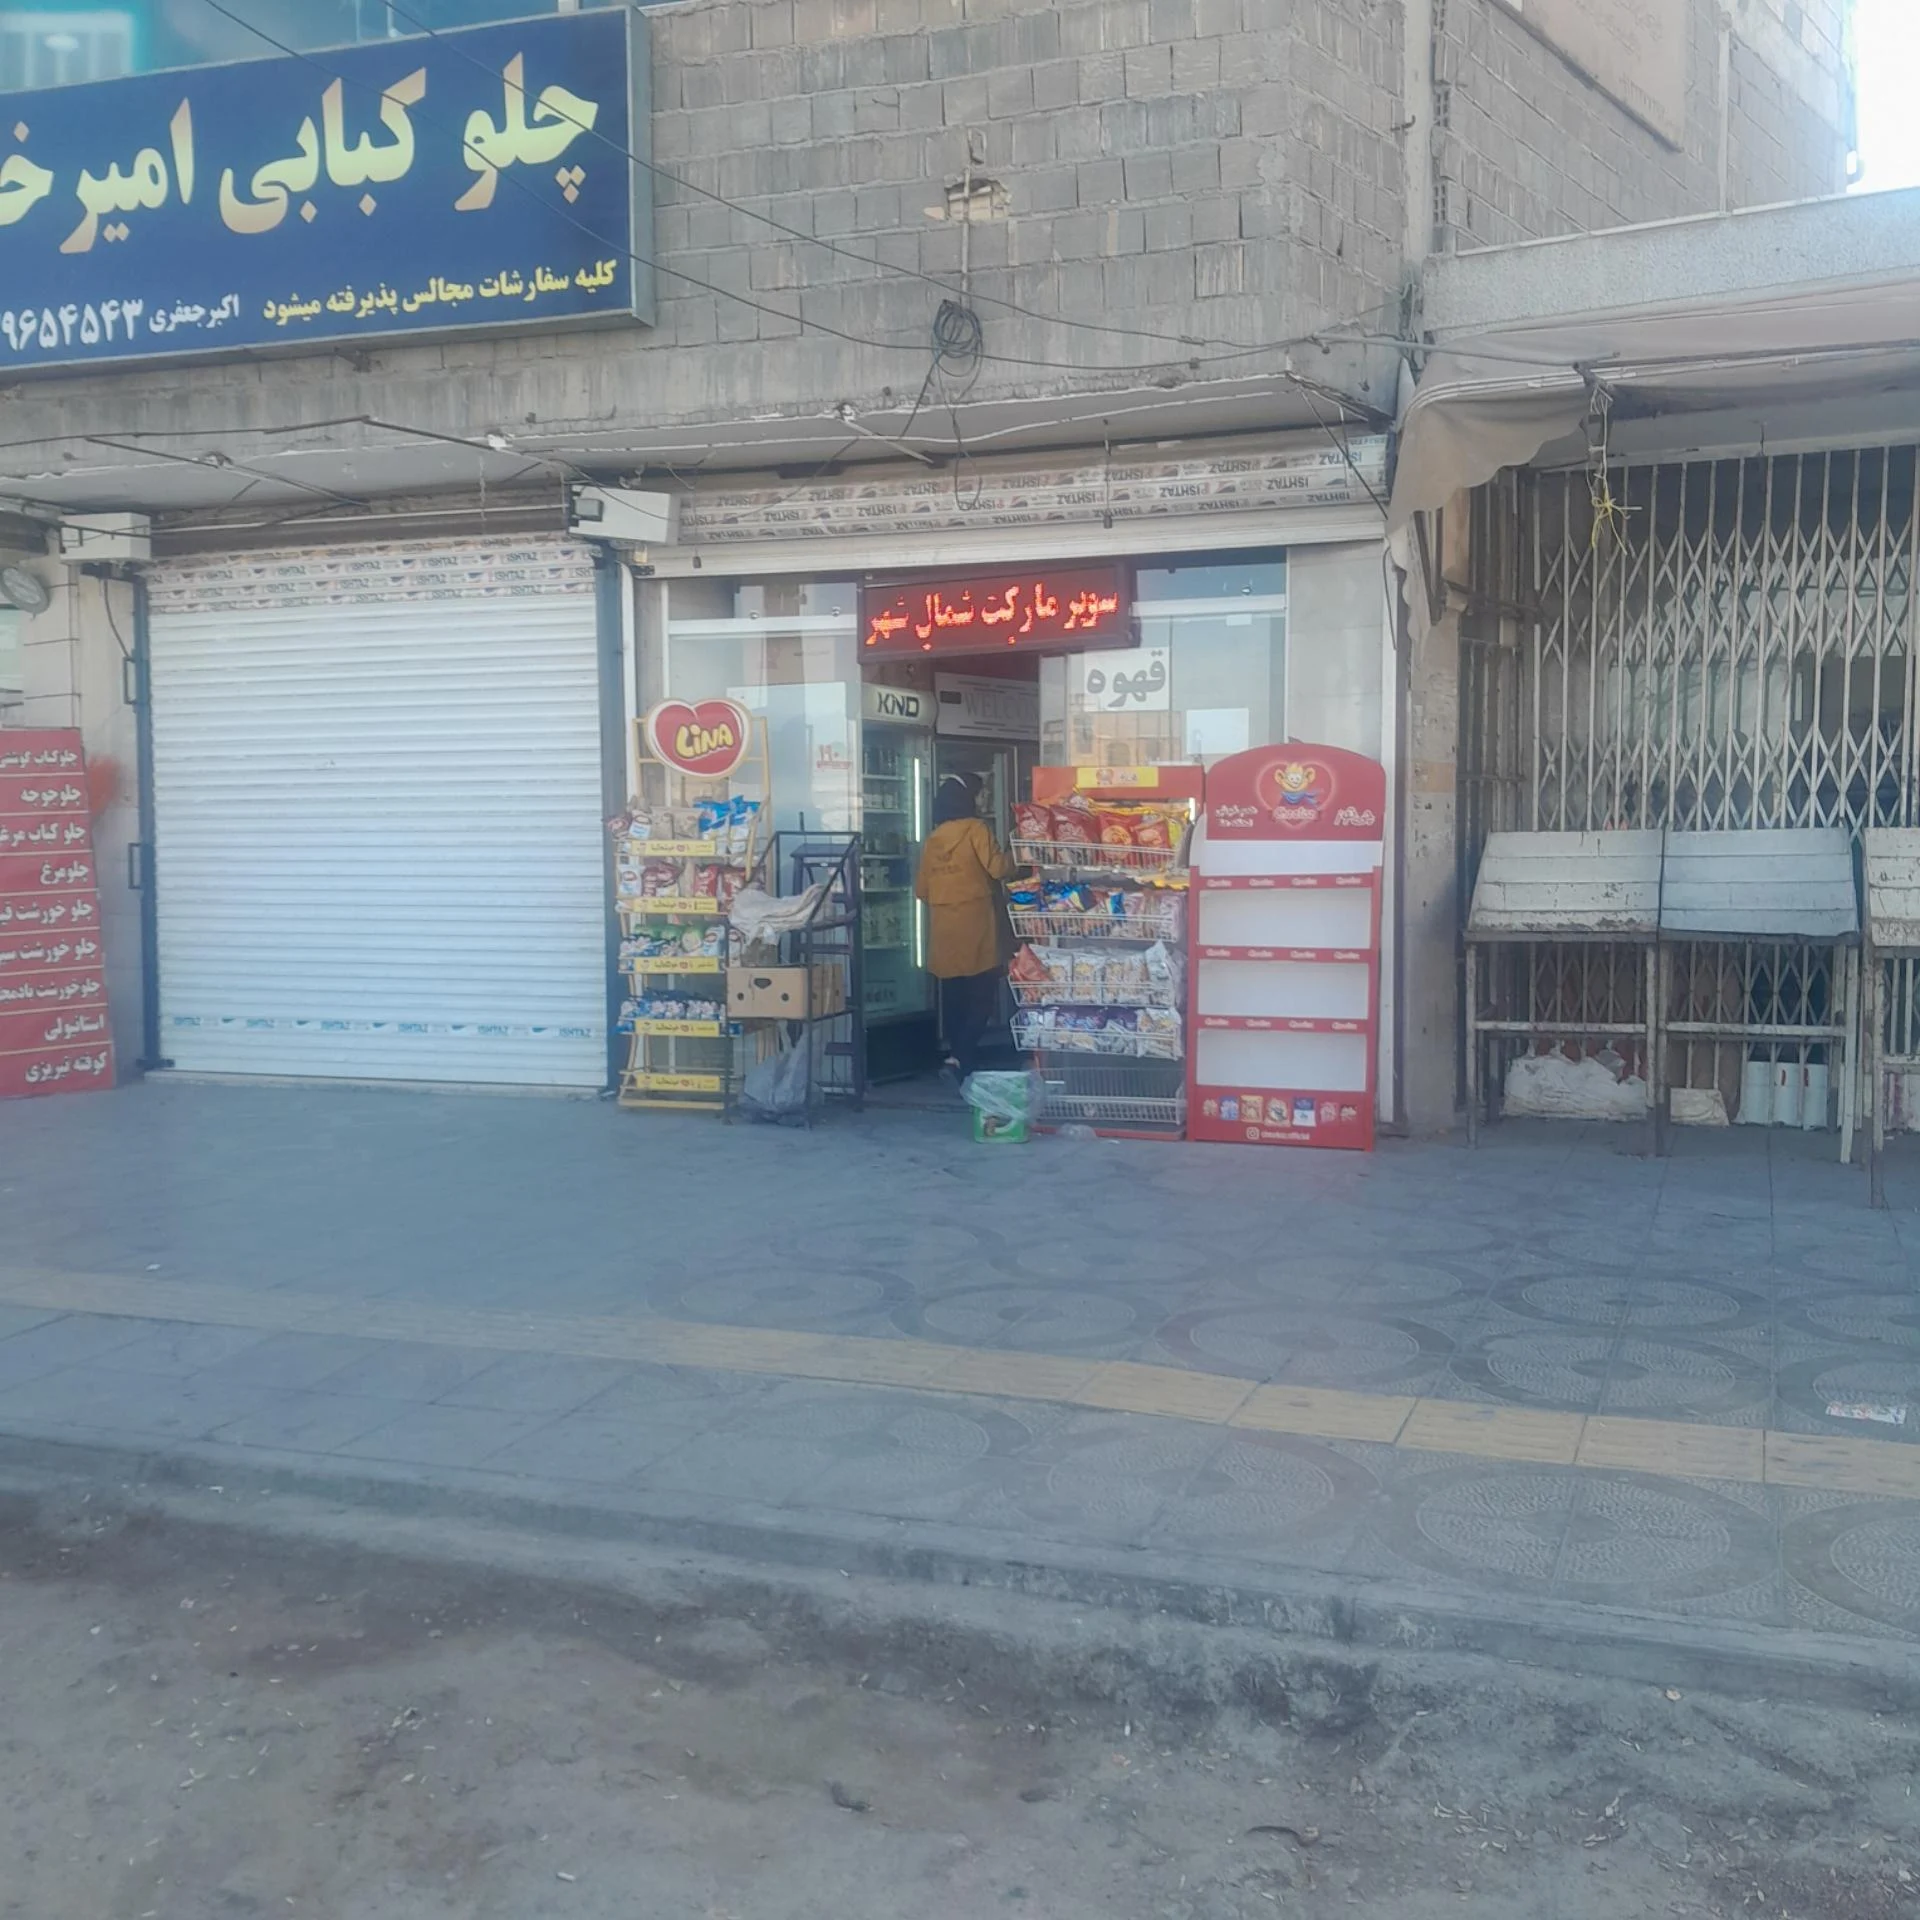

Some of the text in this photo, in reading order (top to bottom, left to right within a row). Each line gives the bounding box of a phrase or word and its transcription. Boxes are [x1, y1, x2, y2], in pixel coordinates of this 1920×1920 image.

[59, 98, 196, 254] امیر
[219, 66, 428, 235] کبابی
[454, 52, 600, 212] چلو
[263, 260, 617, 326] کلیه سفارشات مجالس پذیرفته میشود
[877, 692, 920, 717] KND
[1087, 650, 1166, 708] قهوه
